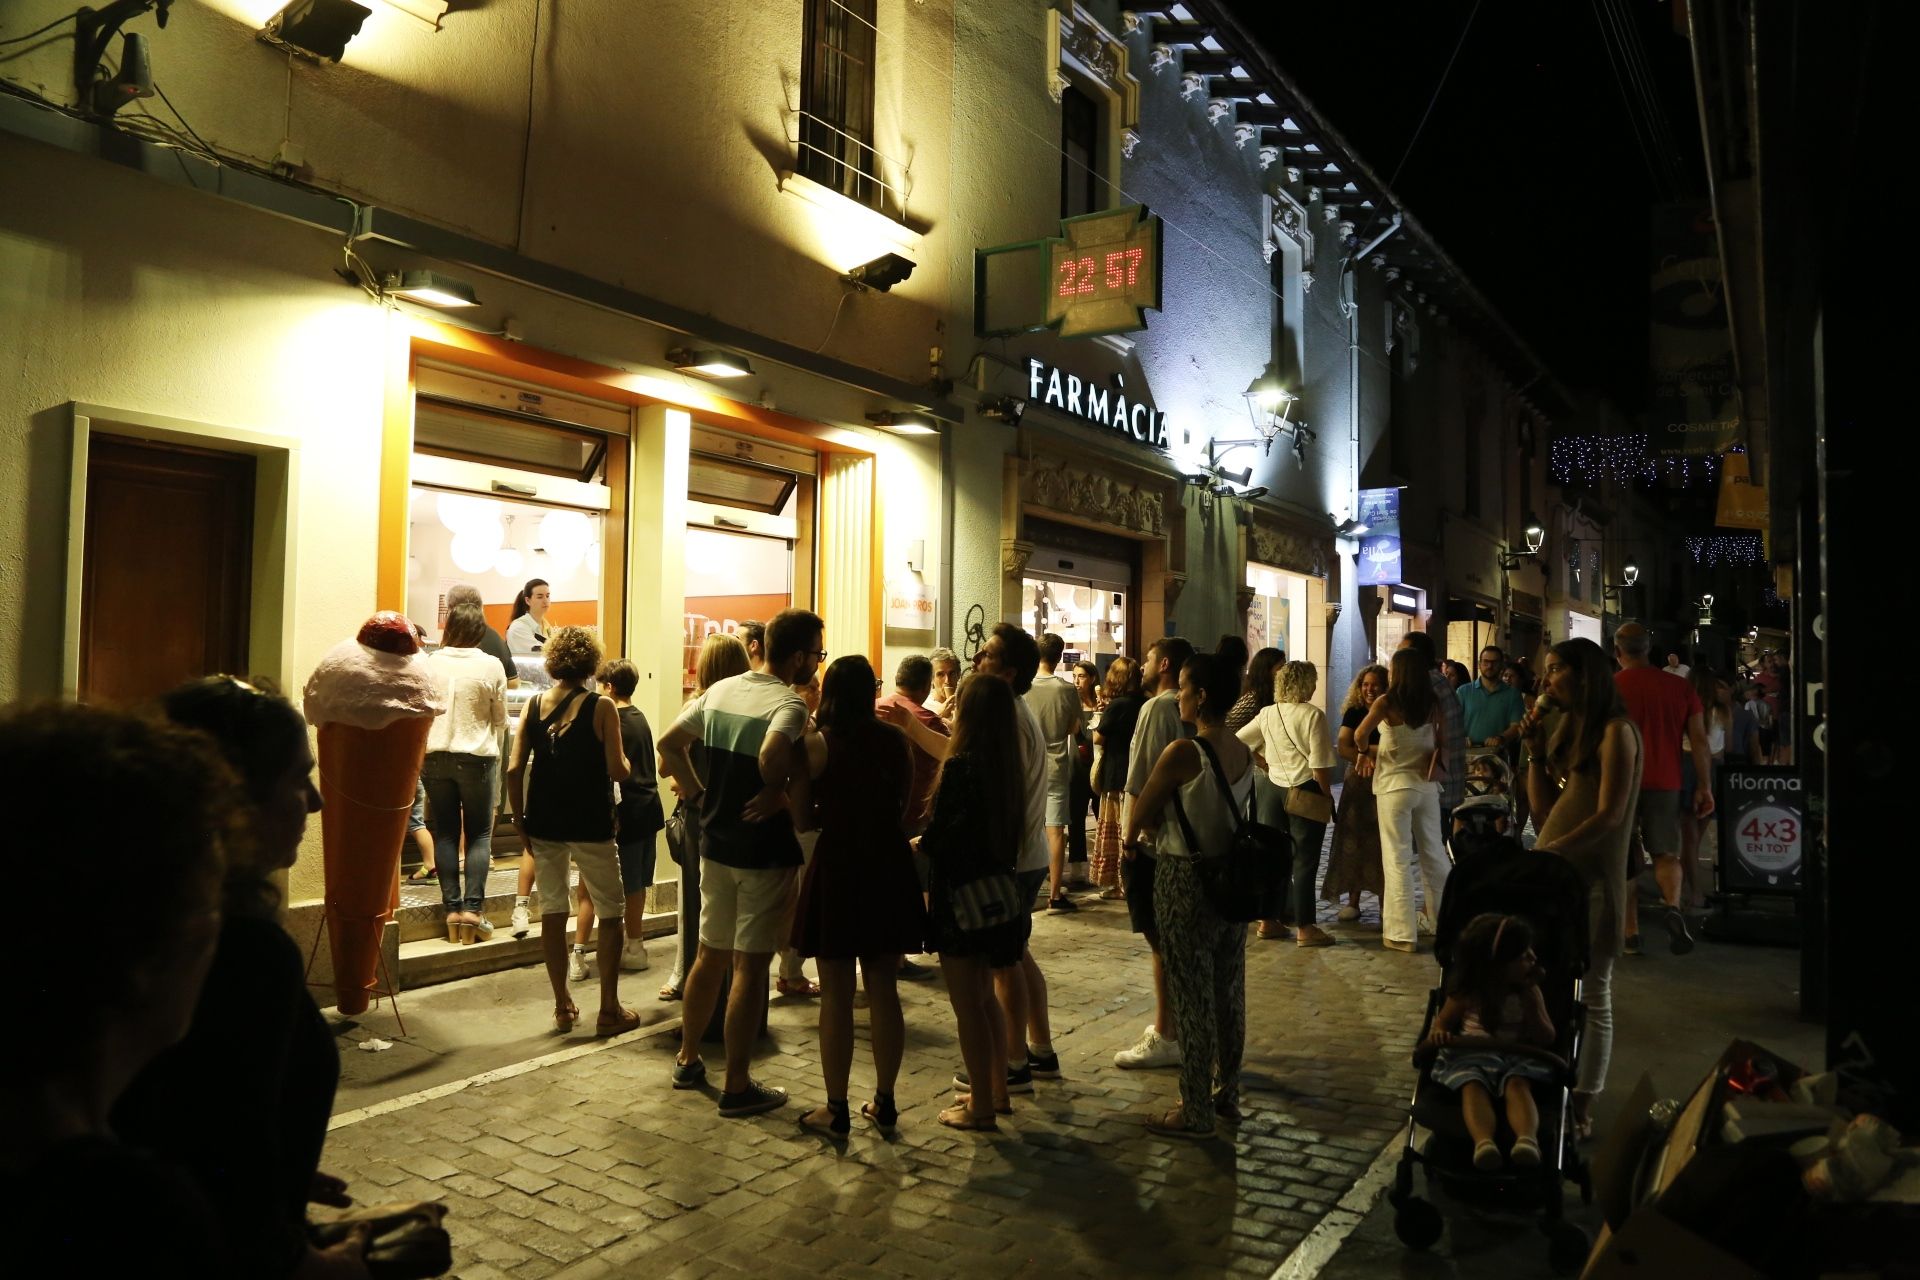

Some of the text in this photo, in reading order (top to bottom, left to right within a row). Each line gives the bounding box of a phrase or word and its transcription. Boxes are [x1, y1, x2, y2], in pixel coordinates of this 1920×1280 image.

[1059, 248, 1142, 296] 22 57
[1030, 358, 1172, 450] FARMÀCIA
[913, 598, 933, 613] PROS
[1742, 818, 1797, 843] 4x3
[1746, 843, 1790, 853] EN TOT
